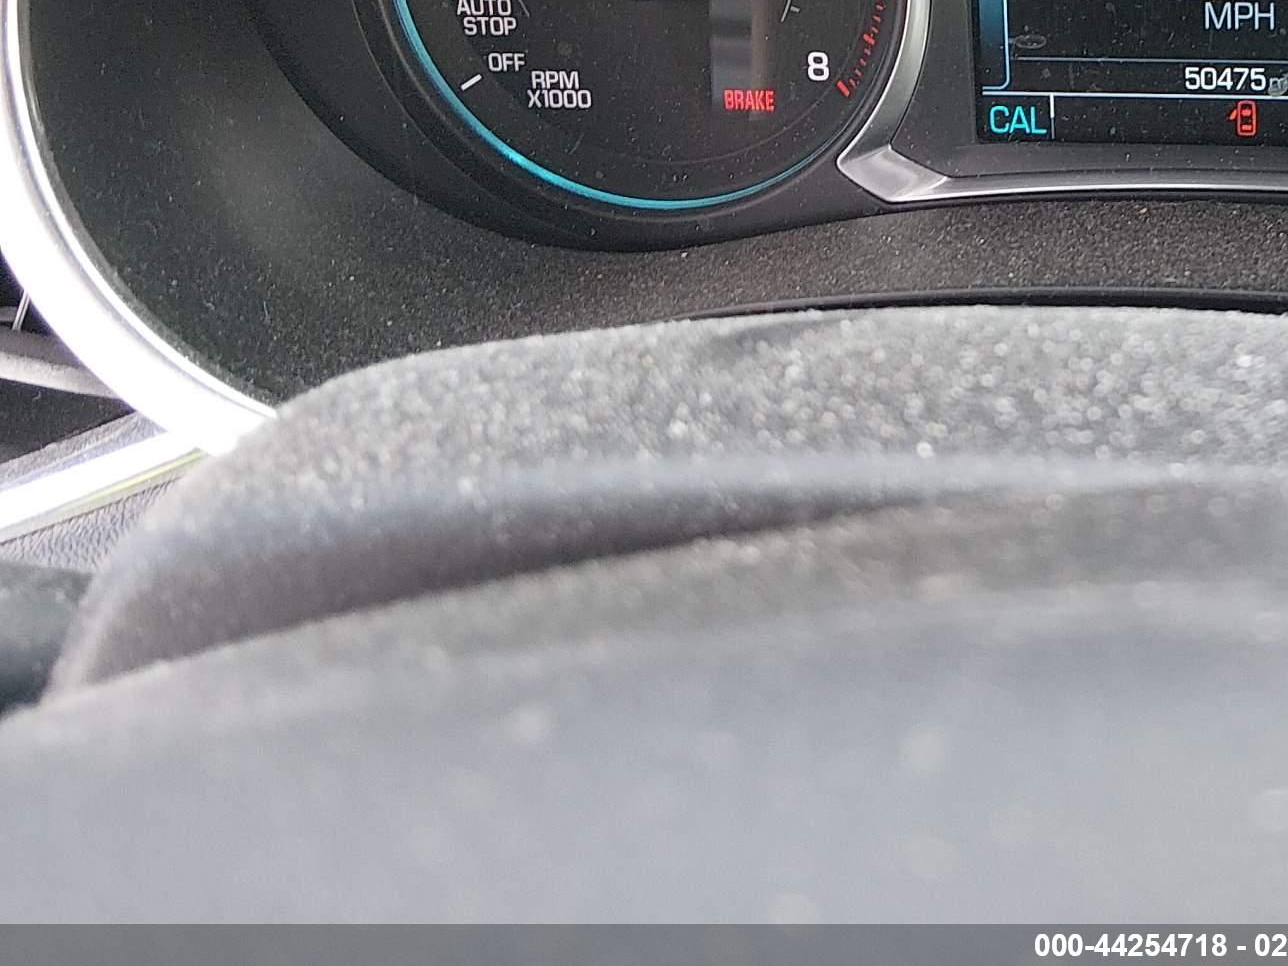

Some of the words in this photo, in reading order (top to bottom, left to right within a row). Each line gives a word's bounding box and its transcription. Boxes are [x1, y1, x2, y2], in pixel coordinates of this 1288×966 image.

[463, 16, 517, 36] STOP
[1204, 1, 1275, 30] MPH
[488, 52, 525, 72] OFF
[807, 51, 830, 81] 8
[531, 71, 579, 90] RPM
[1185, 67, 1266, 91] 50475
[527, 89, 592, 109] X1000
[724, 89, 775, 111] BRAKE
[989, 105, 1047, 134] CAL
